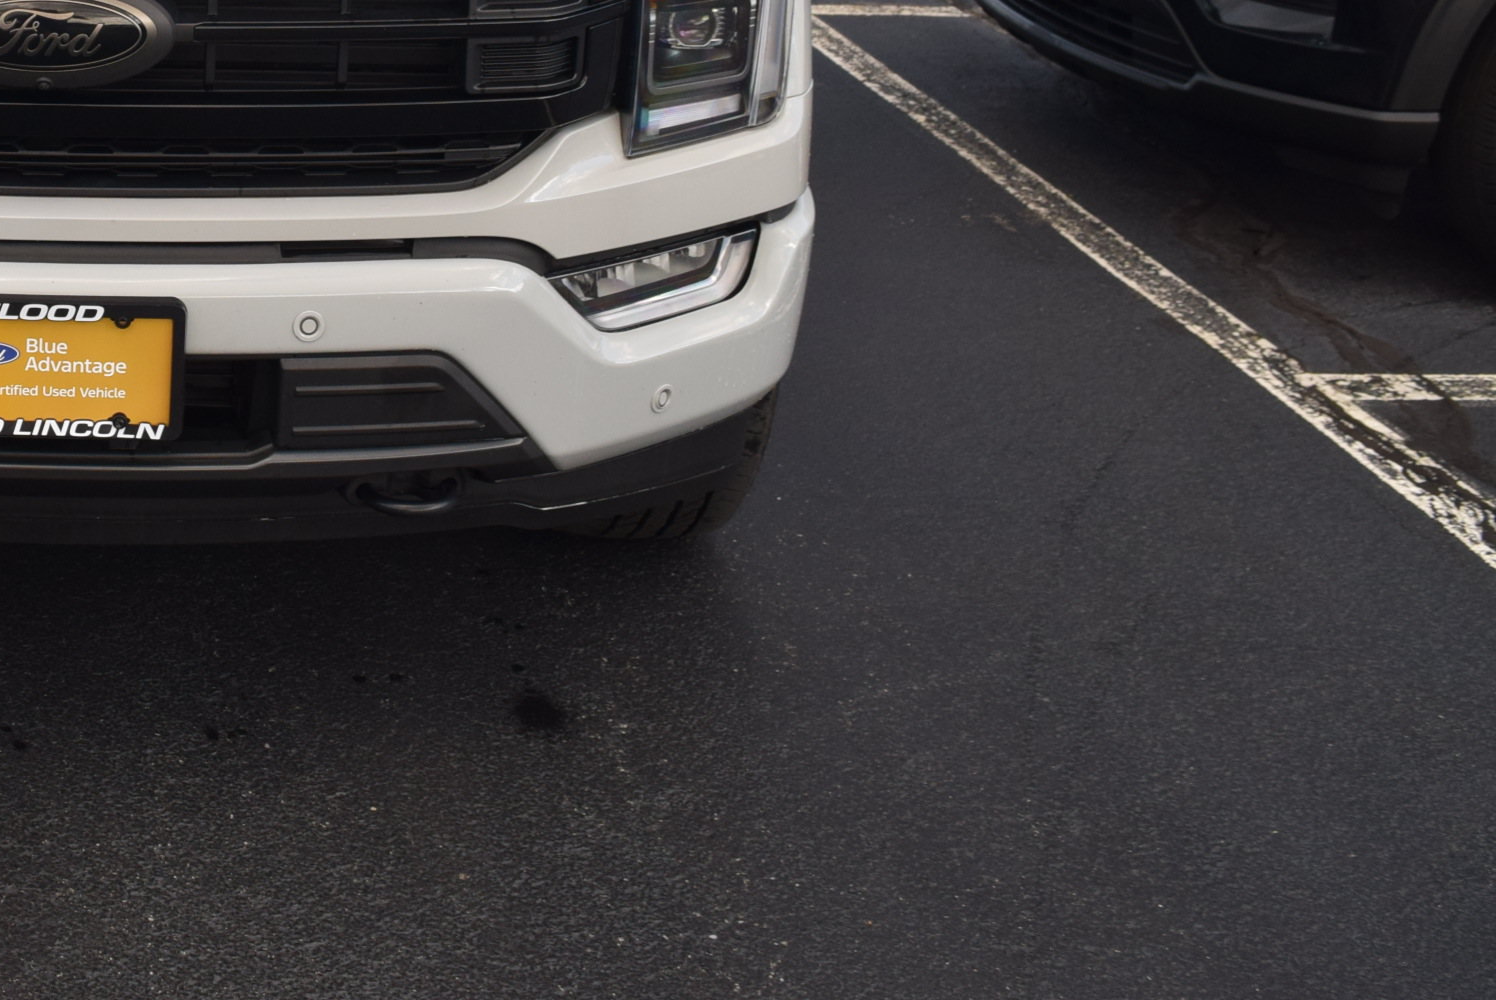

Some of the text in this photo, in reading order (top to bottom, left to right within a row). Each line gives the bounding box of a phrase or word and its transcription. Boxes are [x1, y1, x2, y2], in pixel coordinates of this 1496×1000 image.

[25, 338, 68, 355] Blue
[24, 356, 128, 377] Advantage
[42, 386, 76, 398] Used
[79, 387, 126, 399] Vehicle
[13, 418, 165, 440] LINCOLN
